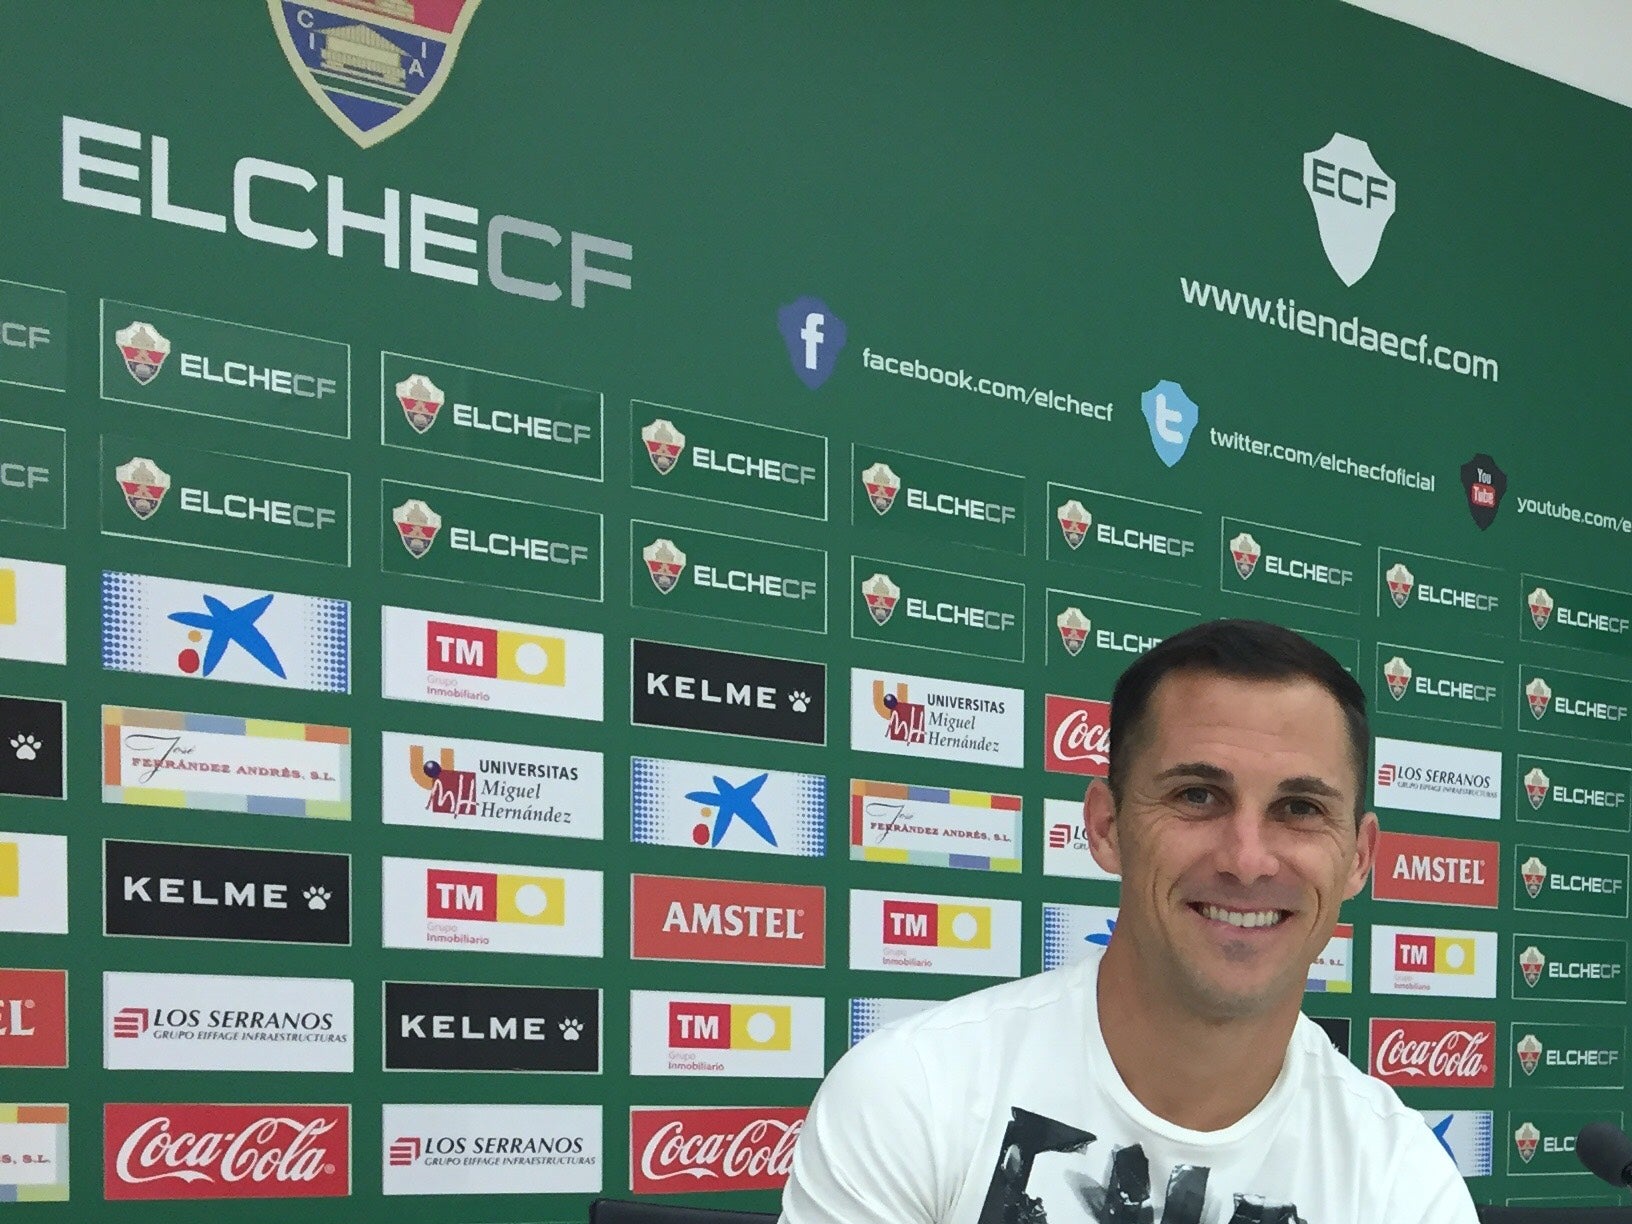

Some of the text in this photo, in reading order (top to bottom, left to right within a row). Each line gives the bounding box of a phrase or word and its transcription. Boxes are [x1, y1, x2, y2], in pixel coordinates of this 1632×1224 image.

[1312, 157, 1388, 209] ECF
[62, 114, 633, 309] ELCHECF
[1180, 276, 1498, 382] www.tiendaecf.com
[180, 352, 337, 399] ELCHECF
[862, 347, 1114, 422] facebook.com/elchecf
[453, 402, 592, 445] ELCHECF
[692, 446, 816, 485] ELCHECF
[1209, 427, 1436, 492] twitter.com/elchecfoficial
[1477, 468, 1492, 485] You
[180, 487, 337, 530] ELCHECF
[906, 488, 1016, 524] ELCHECF
[1472, 485, 1495, 505] Tube
[449, 526, 589, 566] ELCHECF
[1097, 523, 1195, 558] ELCHECF
[693, 565, 817, 600] ELCHECF
[1265, 555, 1353, 587] ELCHECF
[1418, 584, 1499, 612] ELCHECF
[906, 598, 1015, 631] ELCHECF
[1556, 607, 1630, 634] ELCHECF
[435, 635, 484, 668] TM
[1096, 629, 1163, 653] ELCH
[426, 685, 490, 701] Inmobiliario
[646, 672, 776, 710] KELME
[1415, 677, 1497, 702] ELCHECF
[927, 693, 1006, 714] UNIVERSITAS
[1555, 697, 1628, 722] ELCHECF
[928, 712, 976, 732] Miguel
[928, 731, 1000, 753] Hernández
[478, 758, 579, 782] UNIVERSITAS
[1397, 765, 1492, 789] LOS SERRANOS
[480, 778, 542, 804] Miguel
[1553, 785, 1626, 808] ELCHECF
[480, 801, 573, 825] Hernández
[1392, 854, 1485, 885] AMSTEL
[123, 875, 288, 909] KELME
[435, 882, 484, 912] TM
[1550, 873, 1623, 895] ELCHECF
[662, 901, 804, 939] AMSTEL
[889, 912, 928, 938] TM
[426, 932, 490, 945] Inmobiliario
[1399, 943, 1428, 966] TM
[1548, 962, 1621, 980] ELCHECF
[154, 1008, 333, 1030] LOS SERRANOS
[400, 1014, 546, 1041] KELME
[676, 1013, 720, 1040] TM
[153, 1029, 195, 1040] GRUPO
[241, 1031, 348, 1043] INFRAESTRUCTURAS
[1375, 1028, 1490, 1078] Coca-Cola
[1545, 1049, 1619, 1067] ELCHECF
[115, 1115, 339, 1184] Coca-Cola
[424, 1136, 584, 1156] LOS SERRANOS
[640, 1118, 806, 1179] Coca-Col
[424, 1156, 461, 1166] GRUPO
